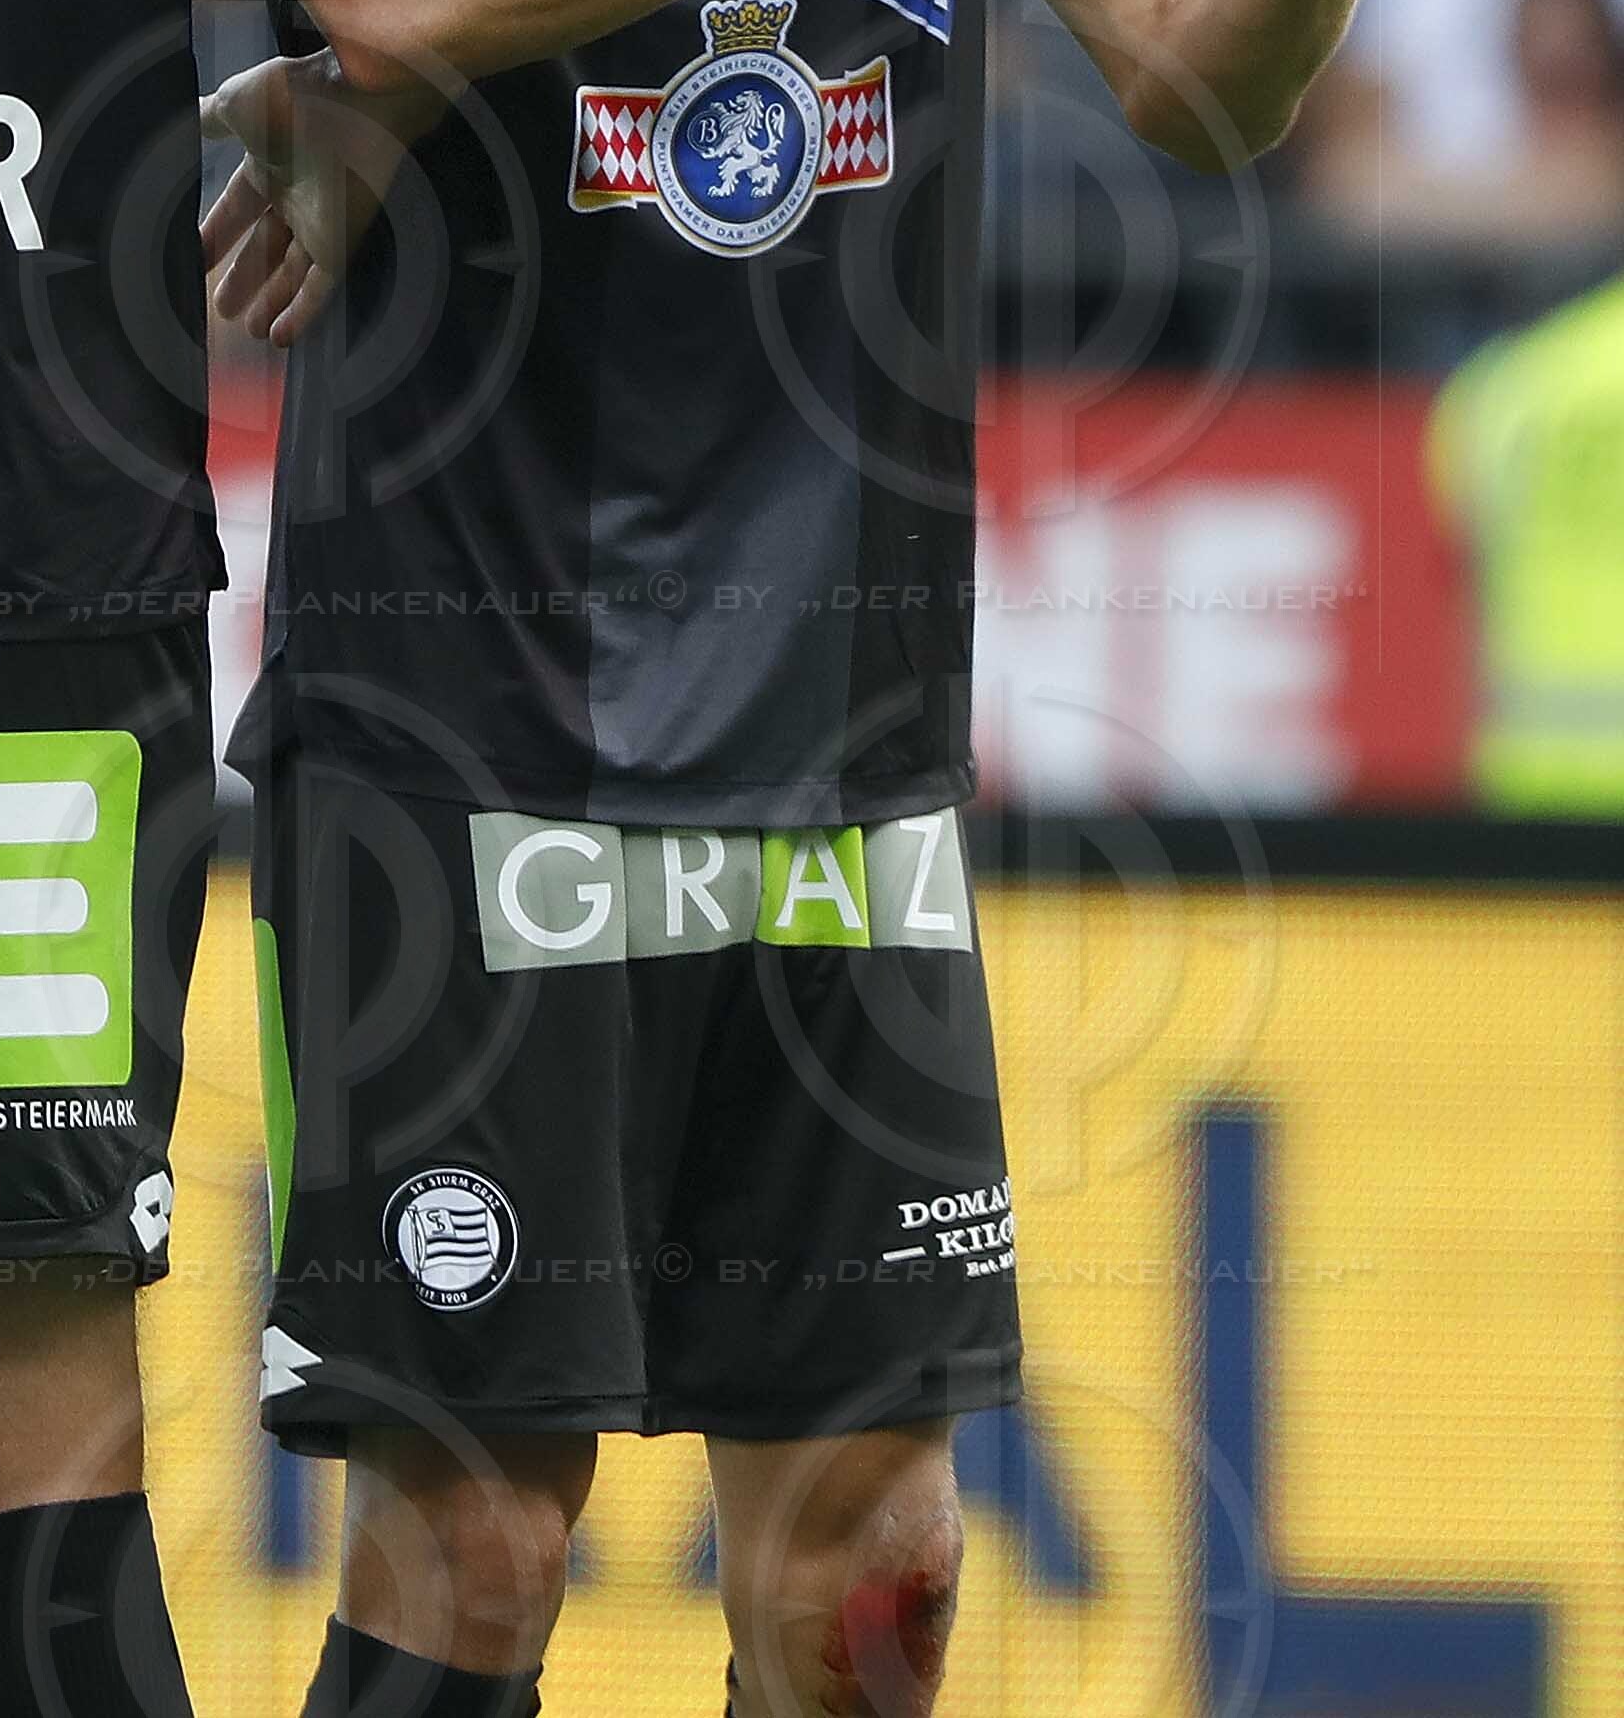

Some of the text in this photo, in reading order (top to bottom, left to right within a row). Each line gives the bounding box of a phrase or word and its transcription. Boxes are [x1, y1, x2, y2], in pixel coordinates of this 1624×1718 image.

[497, 818, 954, 950] GRAZ
[428, 1175, 468, 1188] STURM
[472, 1182, 501, 1211] GRAZ
